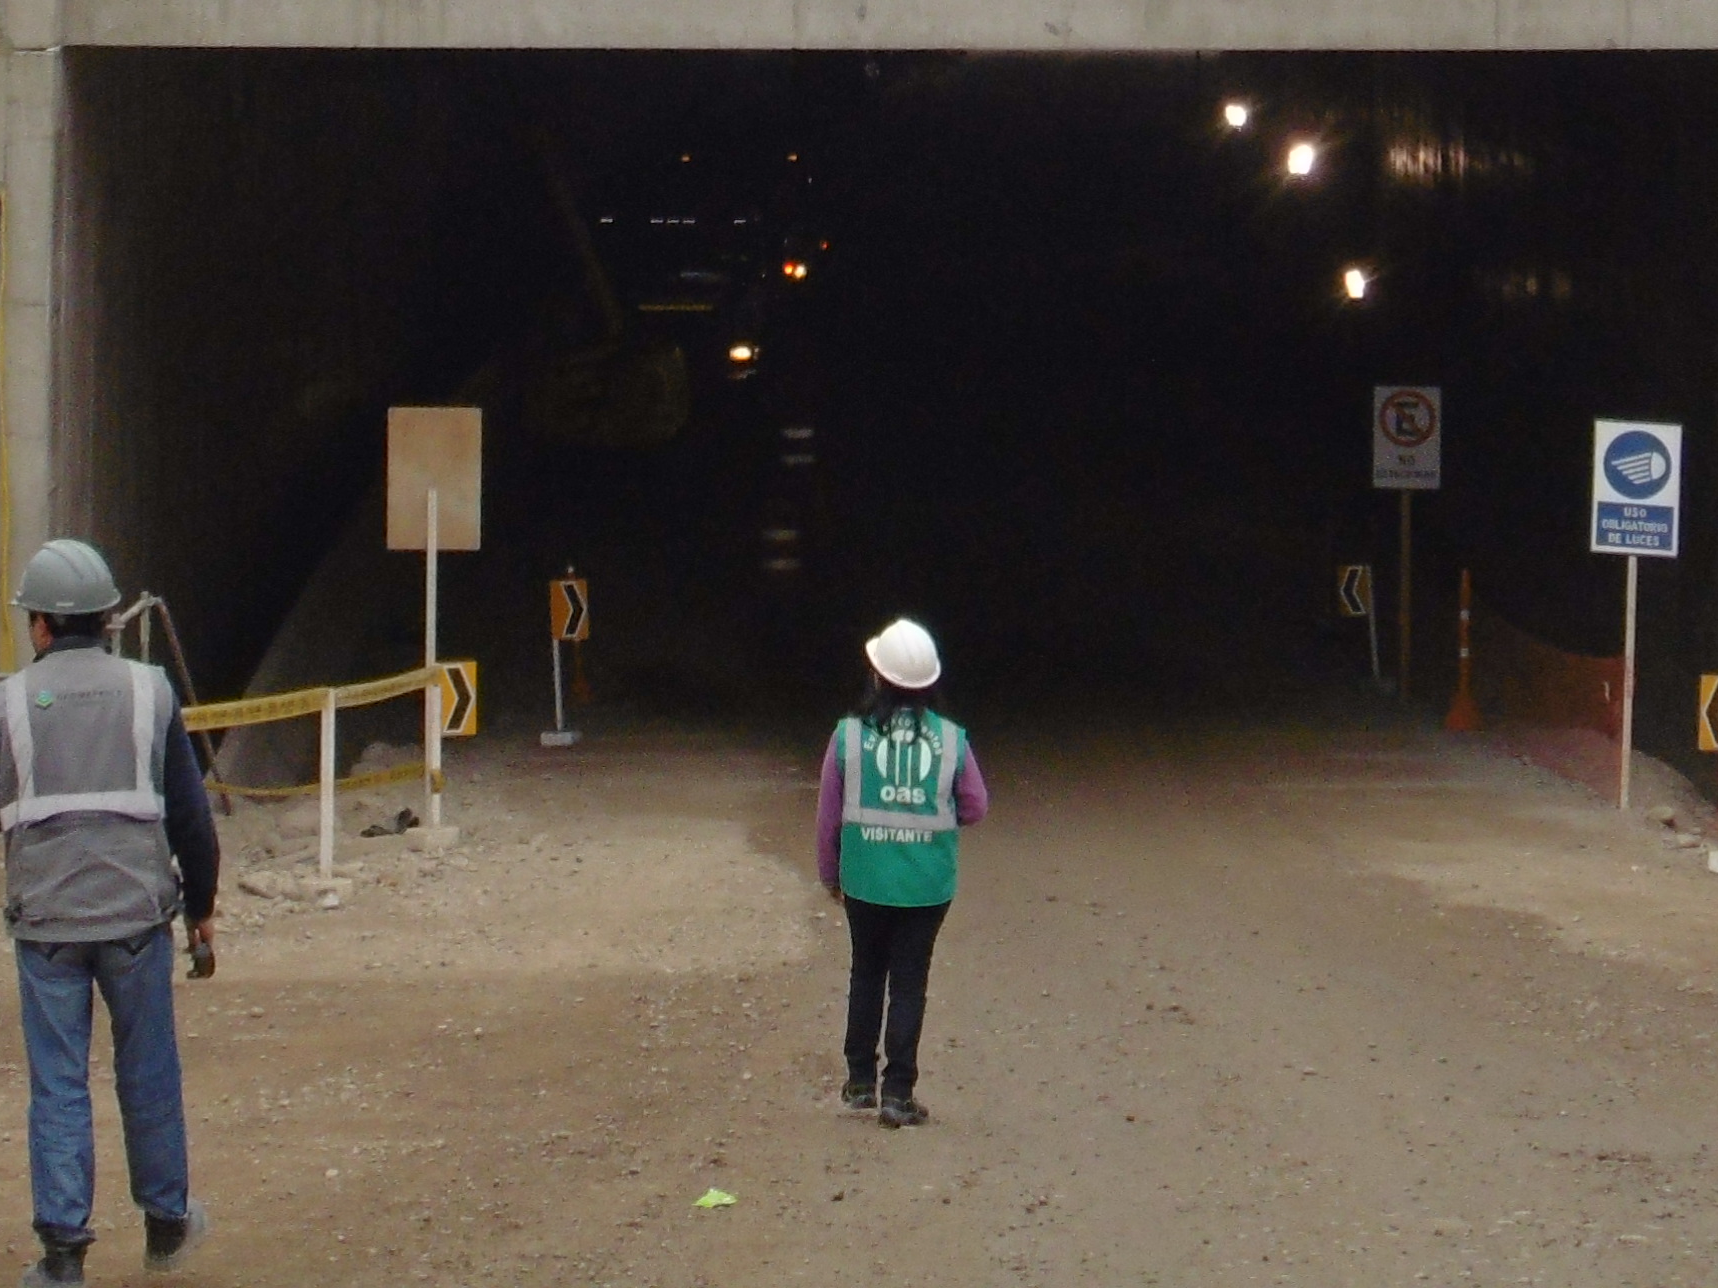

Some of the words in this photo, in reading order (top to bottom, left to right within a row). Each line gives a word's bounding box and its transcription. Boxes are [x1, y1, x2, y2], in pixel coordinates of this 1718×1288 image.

[1624, 507, 1648, 518] USO
[1602, 518, 1669, 534] OBLIGATORIO
[1608, 532, 1622, 544] DE
[1625, 534, 1660, 546] LUCES
[880, 785, 926, 805] oas
[862, 827, 933, 843] VISITANTE
